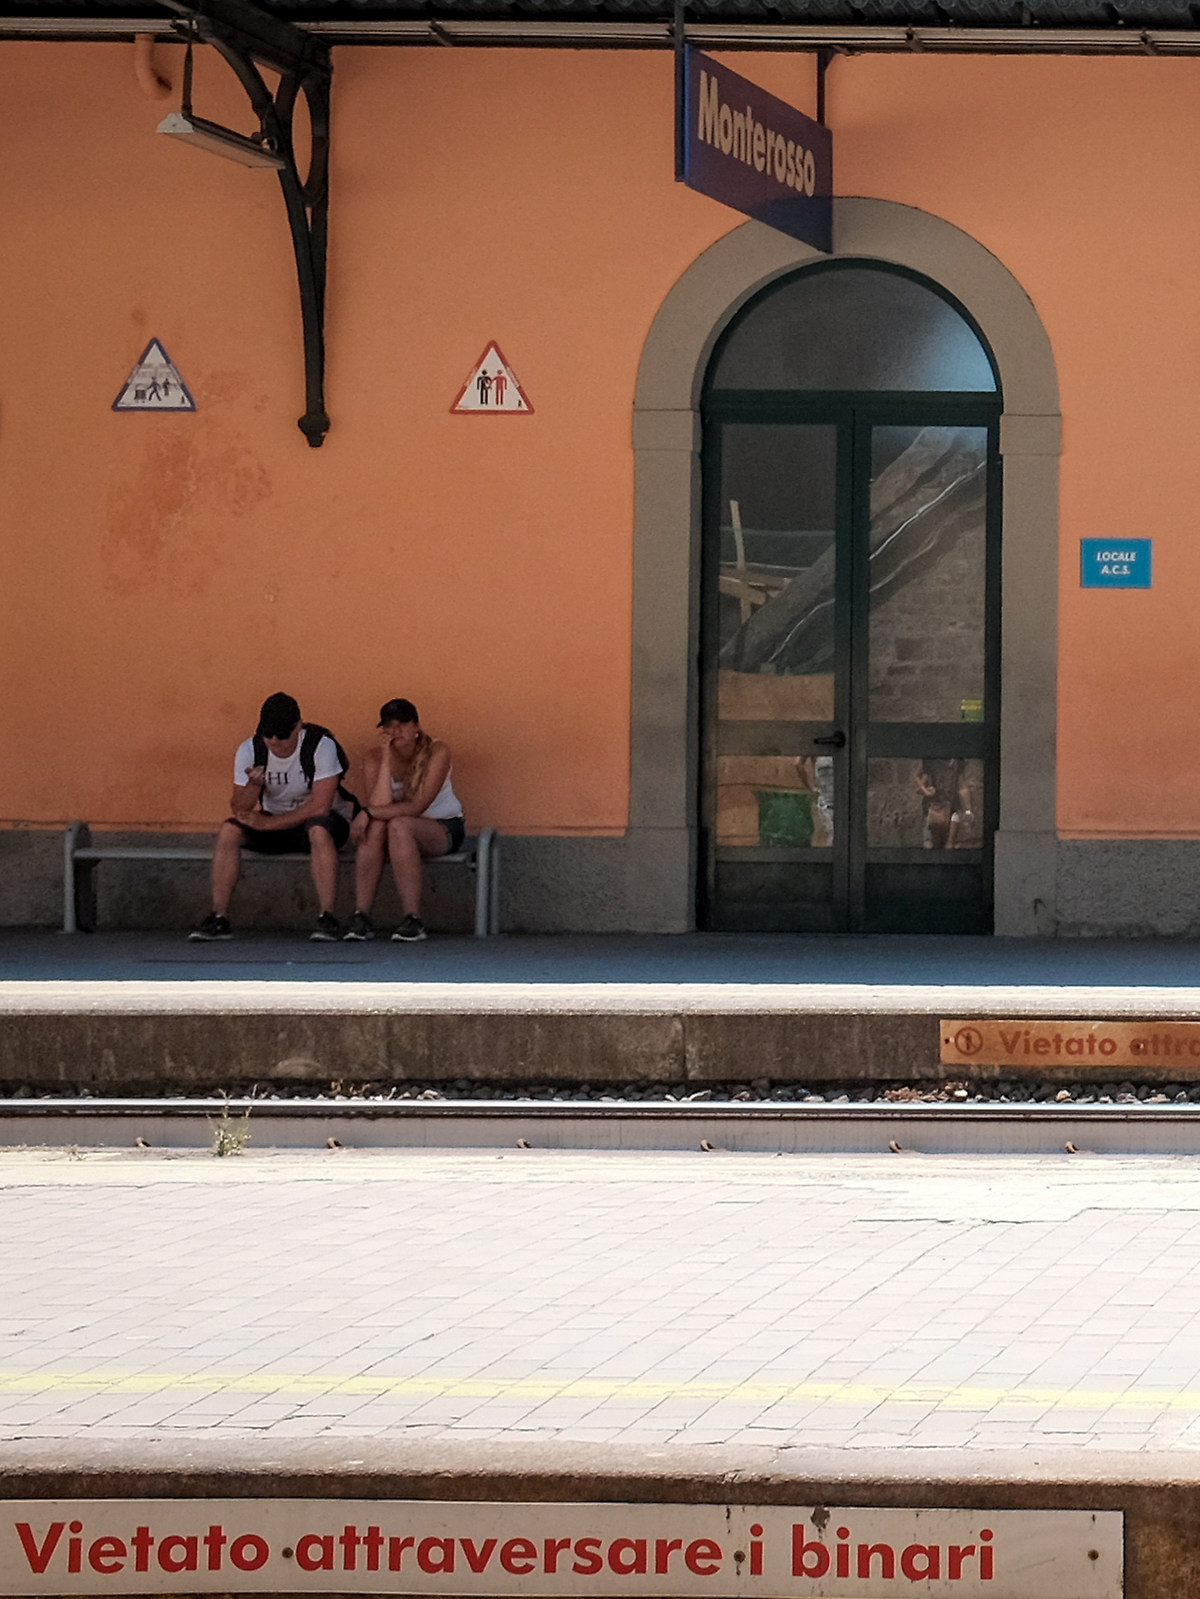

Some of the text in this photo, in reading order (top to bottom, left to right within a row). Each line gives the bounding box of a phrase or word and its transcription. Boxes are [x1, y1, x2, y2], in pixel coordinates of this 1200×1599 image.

[698, 69, 816, 197] Monterosso
[1096, 551, 1137, 562] LOCALE
[1000, 1030, 1118, 1056] Vietato
[15, 1520, 994, 1580] Vietato attraversare i binari
